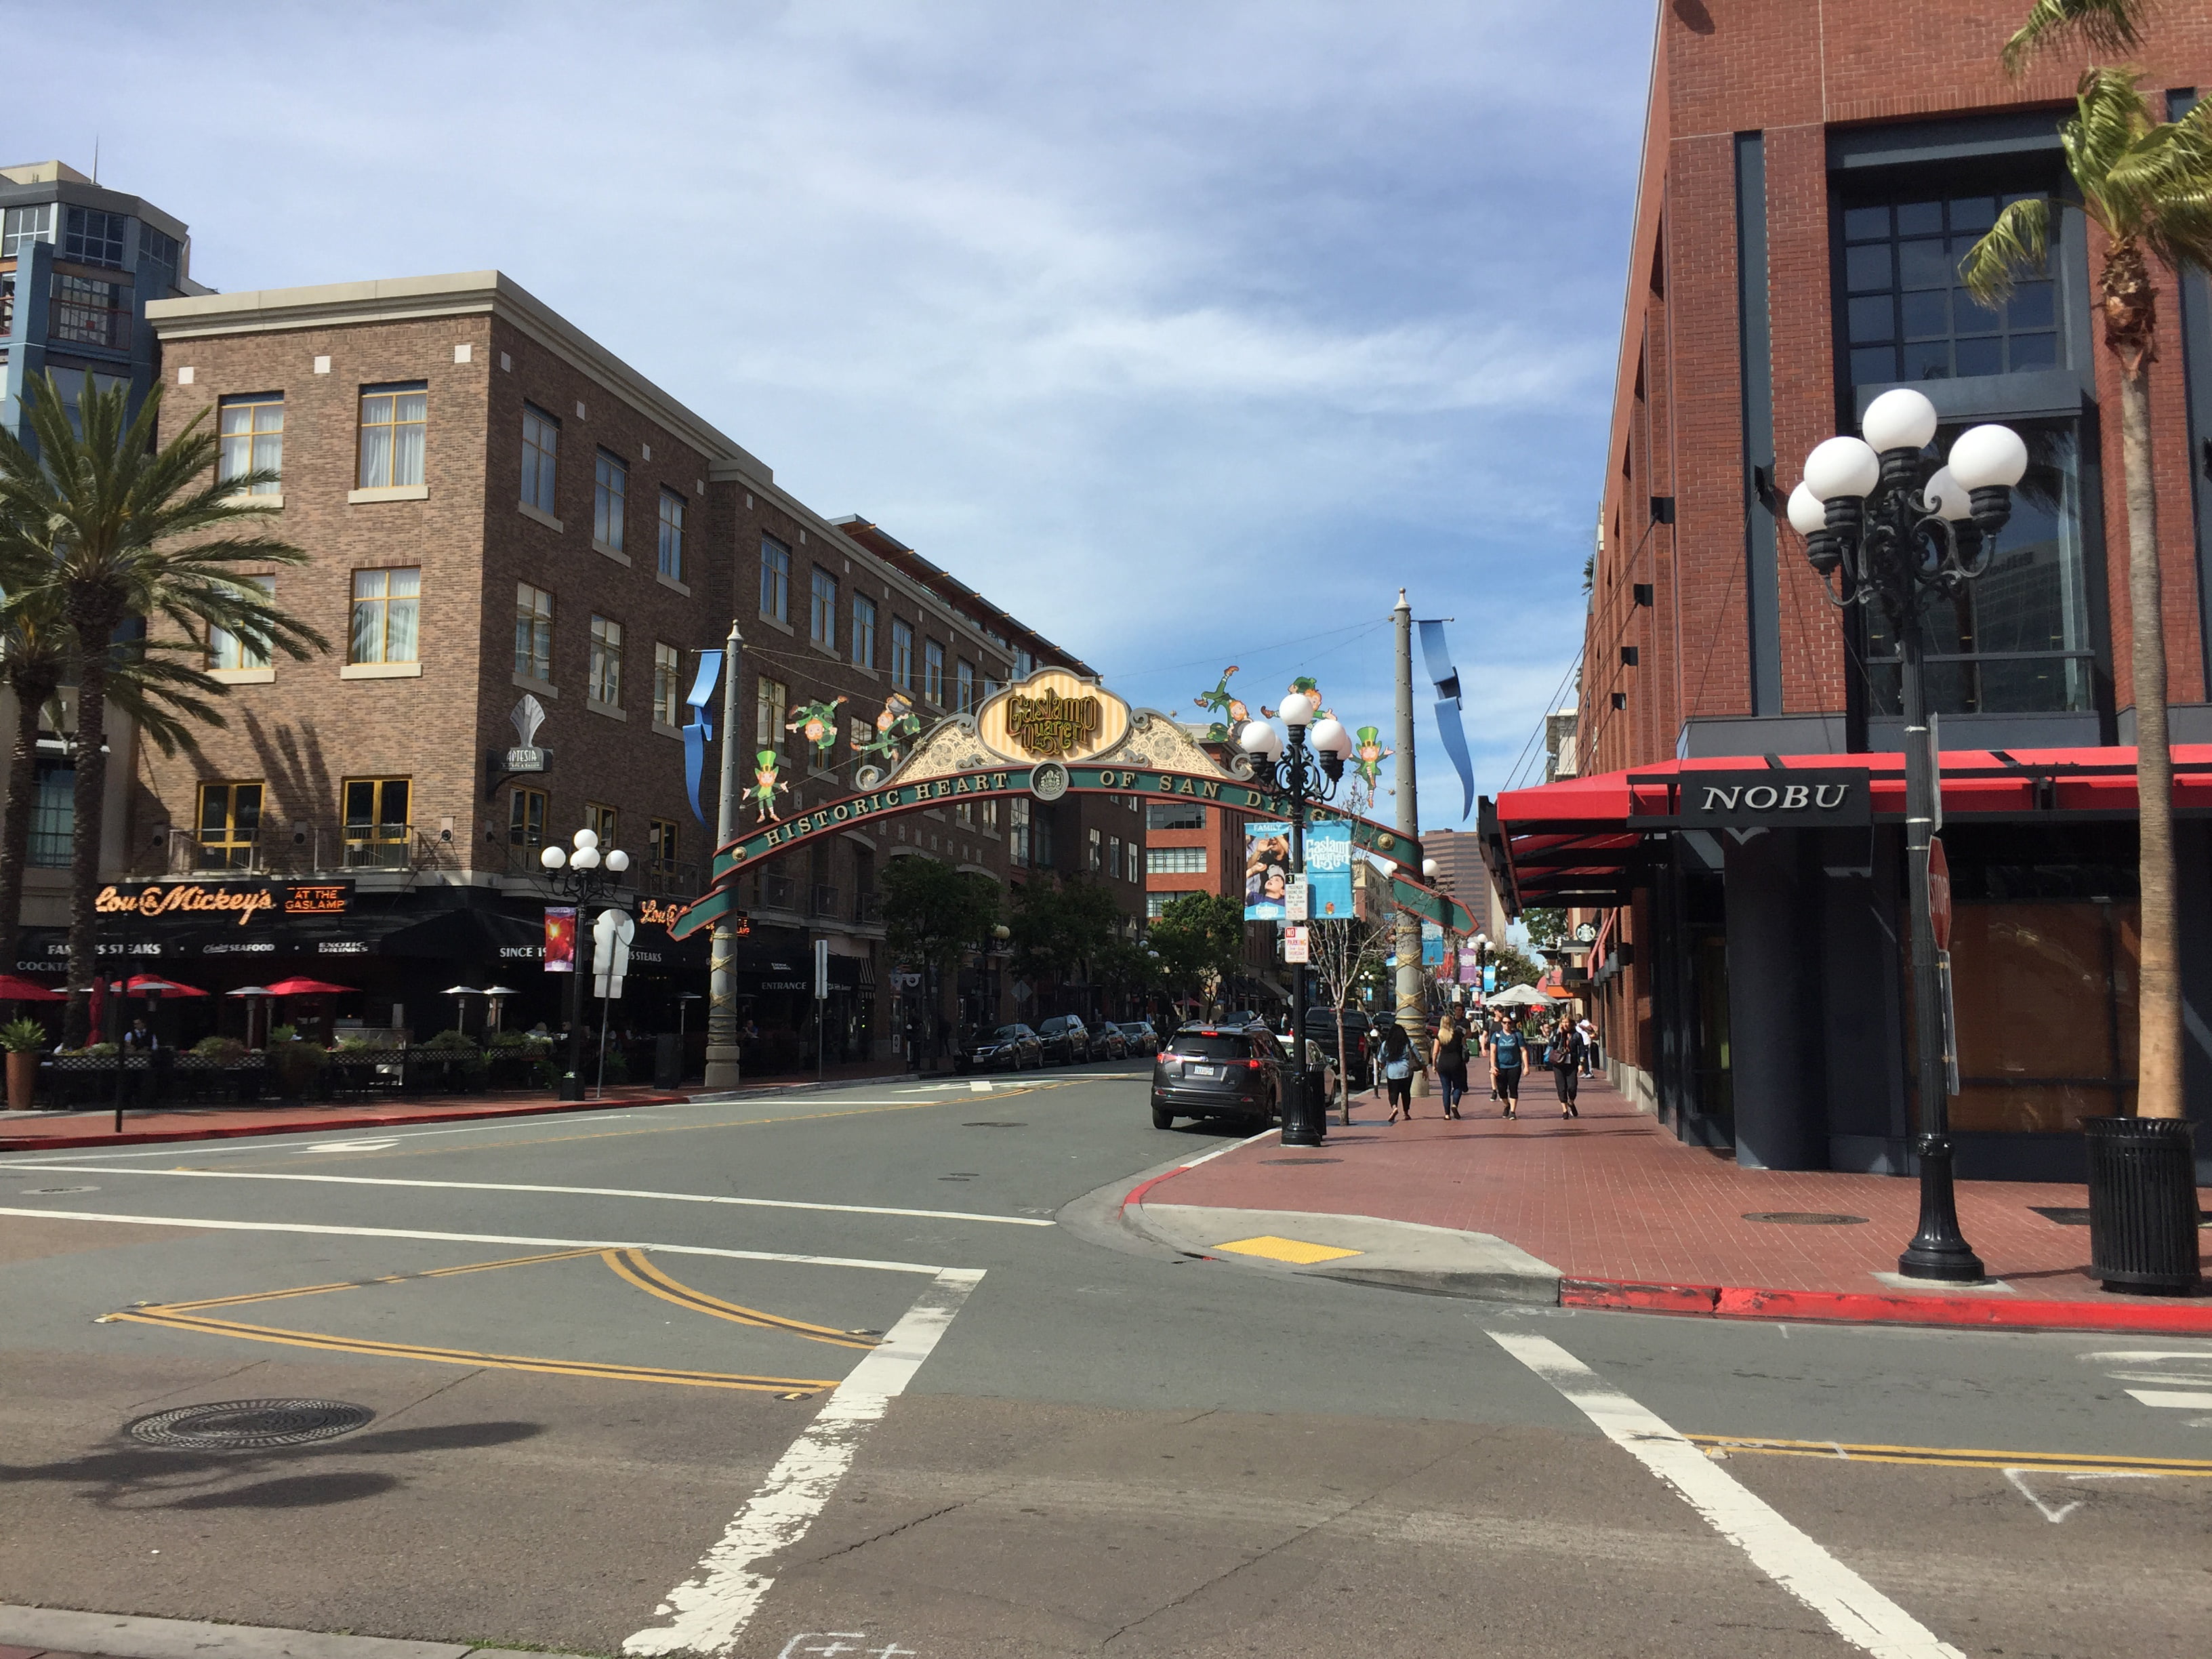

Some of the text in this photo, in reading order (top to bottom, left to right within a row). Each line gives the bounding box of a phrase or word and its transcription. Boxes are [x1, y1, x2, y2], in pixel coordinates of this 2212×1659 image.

[1005, 687, 1097, 744] Gaslamp
[1021, 720, 1084, 755] Quarter
[1701, 785, 1849, 810] NOBU
[764, 770, 1326, 847] HISTORIC HEART OF SAN DIG
[1288, 875, 1292, 884] 3
[295, 890, 337, 899] AT THE
[1930, 873, 1948, 915] STOP
[95, 886, 138, 912] Lou
[161, 885, 274, 926] Mickey's
[285, 900, 345, 909] GASLAMP
[1287, 928, 1294, 937] NO
[228, 943, 275, 951] SEAFOOD
[499, 947, 533, 958] SINCE
[636, 951, 662, 962] STEAKS
[762, 982, 807, 990] ENTRANCE
